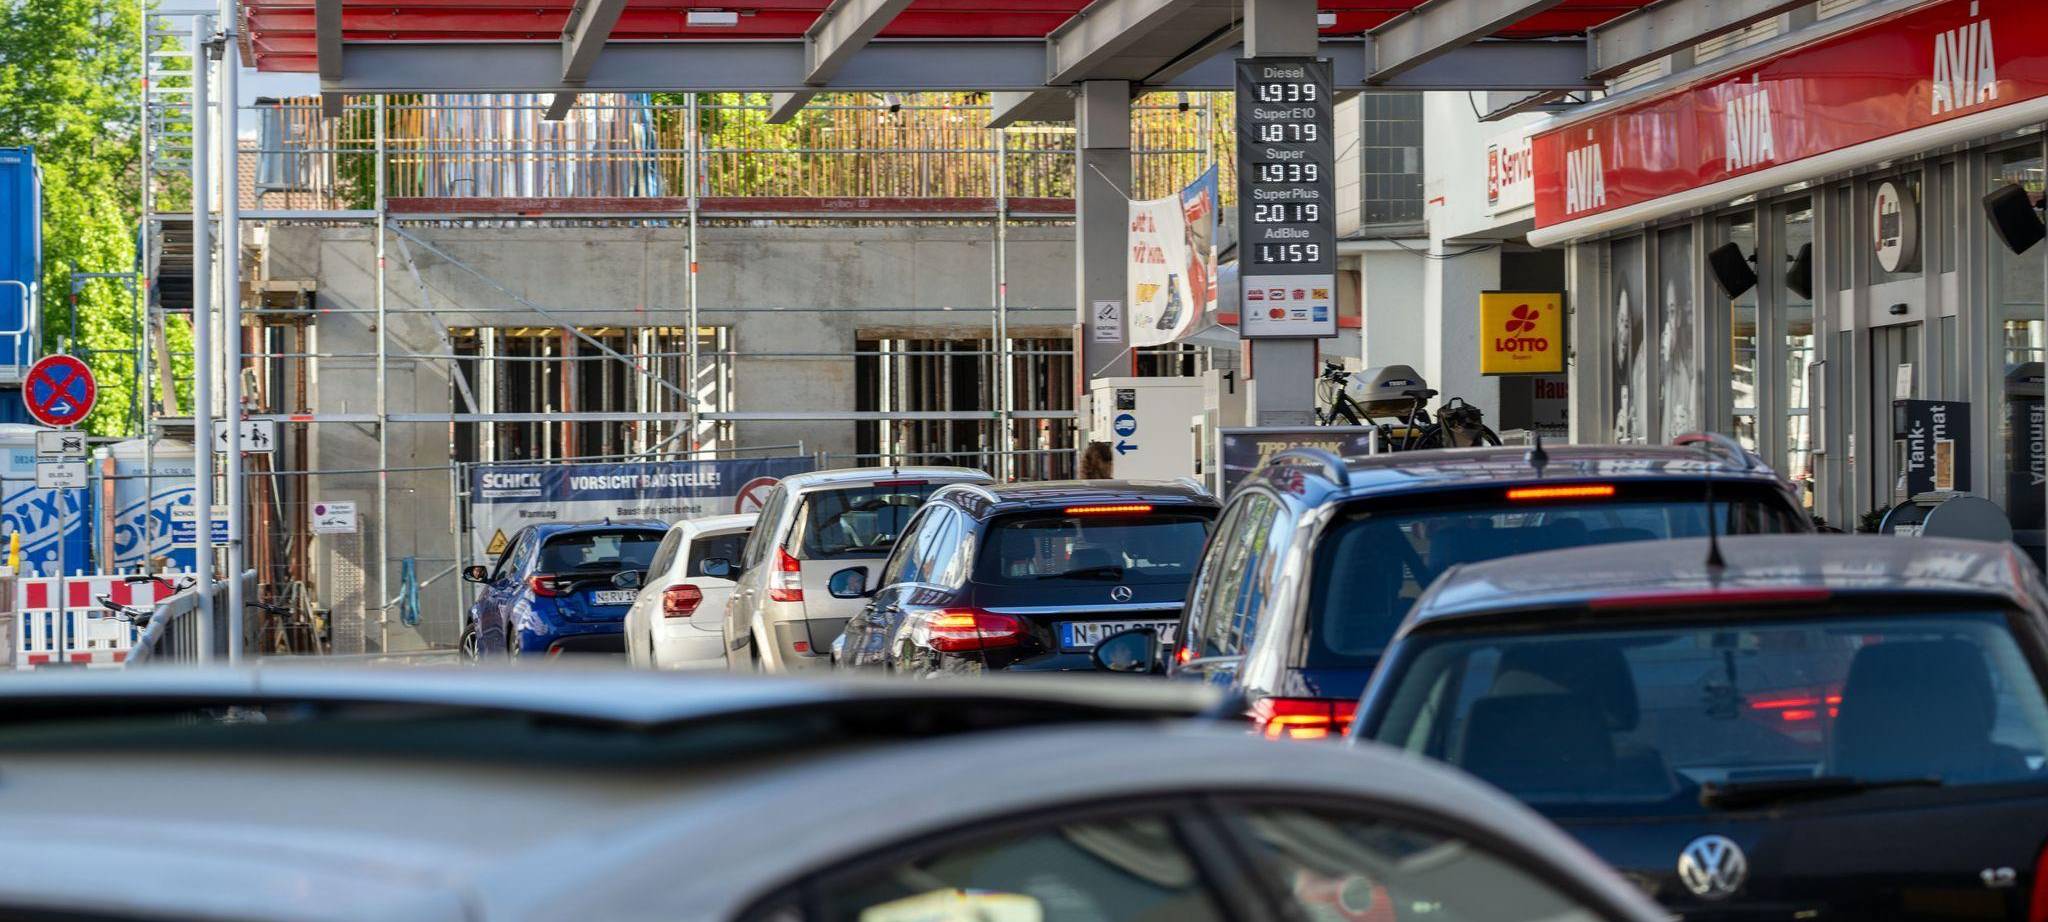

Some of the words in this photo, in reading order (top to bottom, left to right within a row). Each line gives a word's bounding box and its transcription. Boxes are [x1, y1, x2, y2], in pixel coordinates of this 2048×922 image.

[1931, 0, 1998, 116] AVIA
[1264, 67, 1305, 79] Diesel
[1260, 84, 1316, 102] 1.939
[1726, 72, 1776, 173] AVIA
[1261, 124, 1318, 142] 1.879
[1266, 148, 1305, 160] Super
[1261, 164, 1318, 182] 1.939
[1566, 128, 1607, 215] AVIA
[1253, 189, 1290, 201] Super
[1292, 187, 1319, 199] Plus
[1255, 204, 1319, 222] 2.019
[1264, 227, 1310, 239] AdBlue
[1263, 244, 1319, 262] 1.159
[1495, 337, 1548, 352] LOTTO
[1223, 370, 1235, 395] 1
[1908, 420, 1925, 472] Tank-
[482, 473, 542, 489] SCHICK
[570, 475, 639, 491] VORSICHT
[641, 473, 721, 488] BAUSTELLE!
[1074, 625, 1087, 644] N
